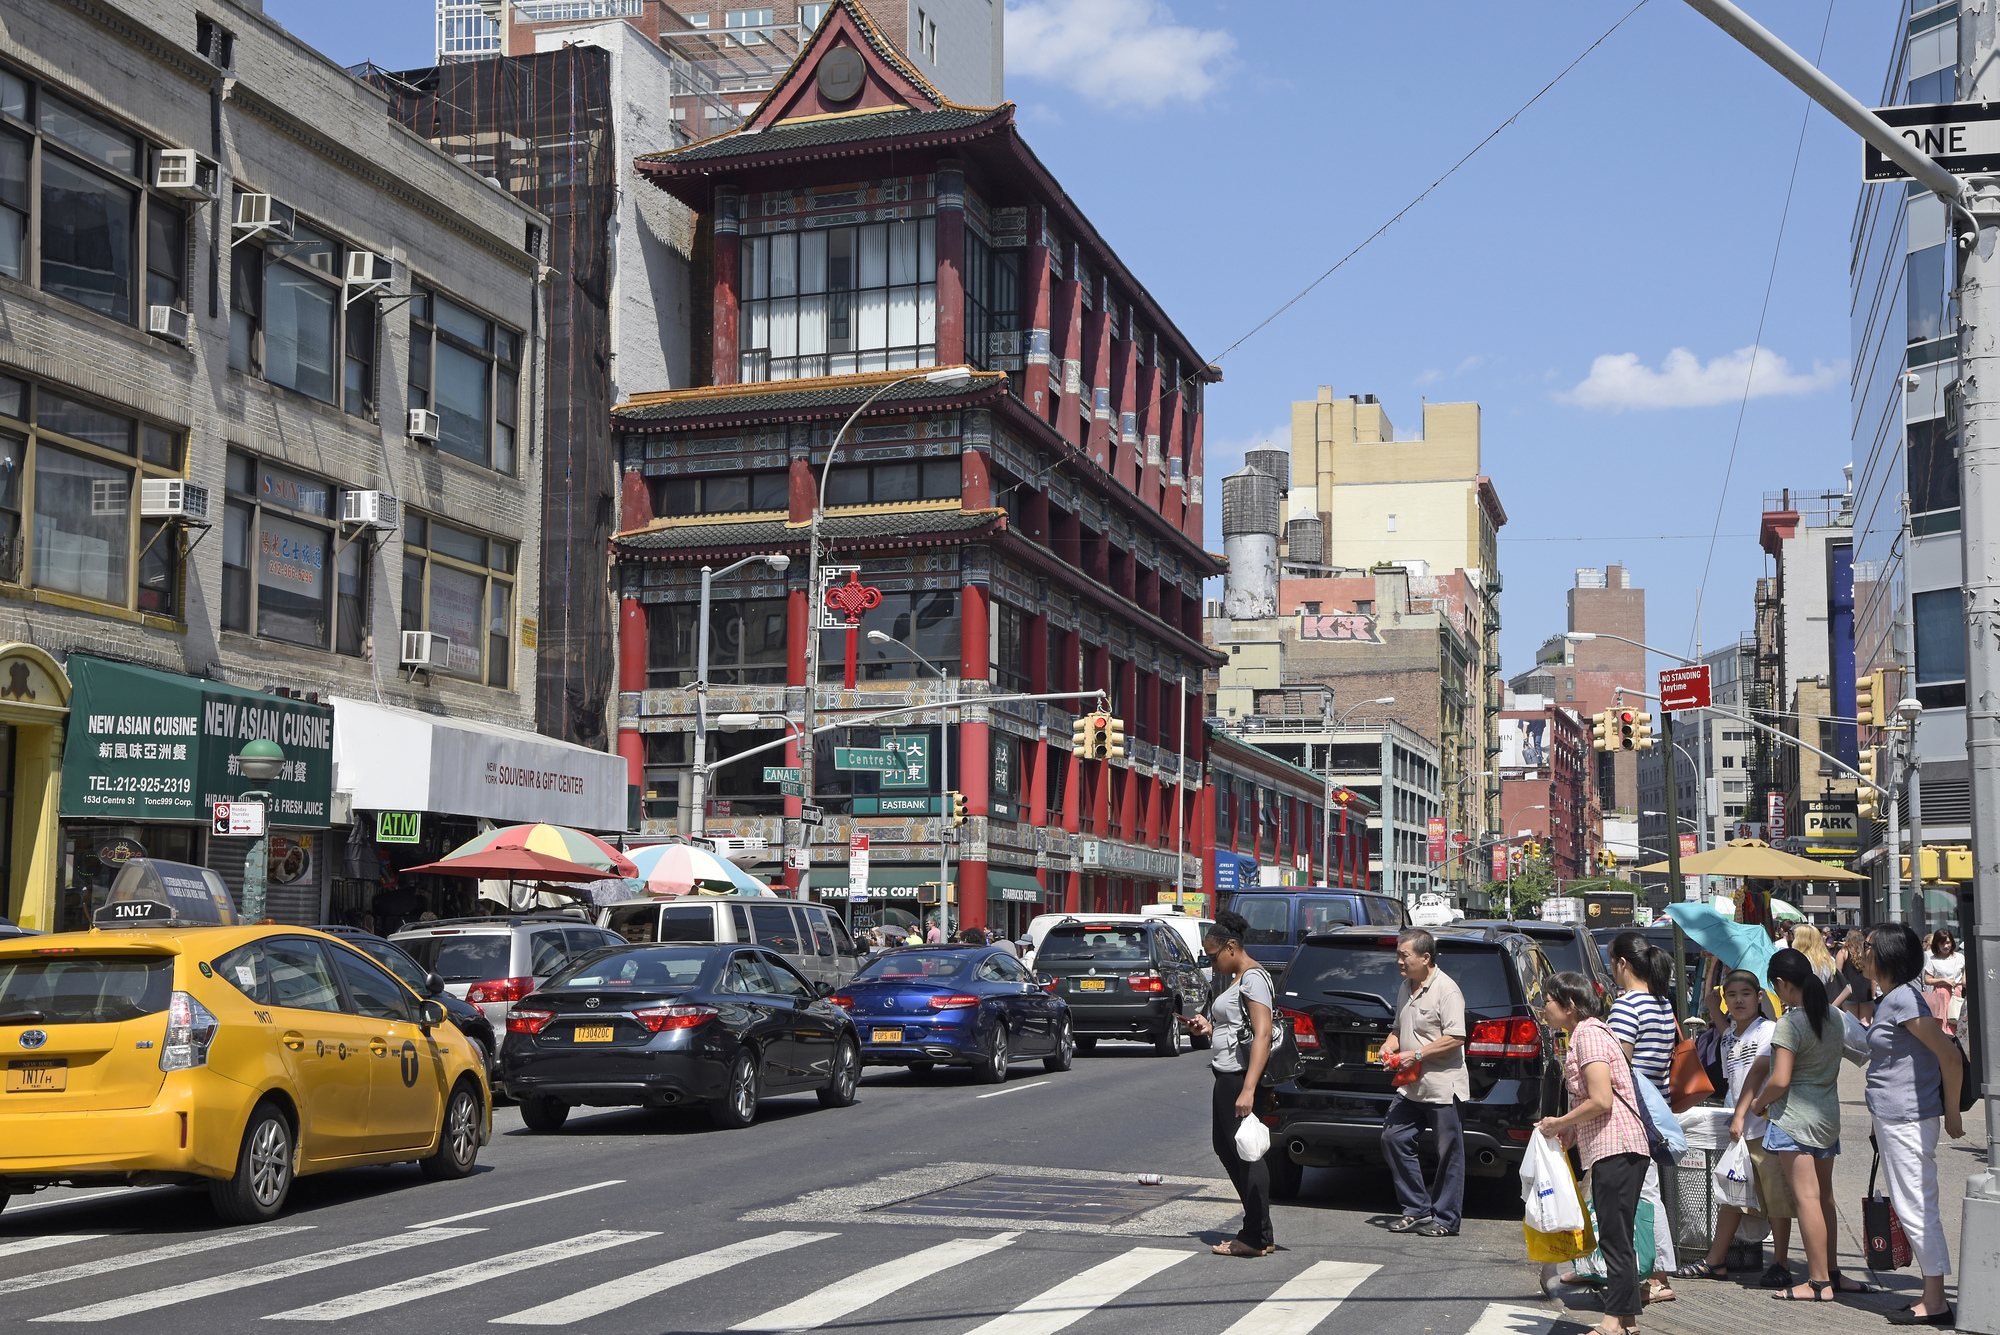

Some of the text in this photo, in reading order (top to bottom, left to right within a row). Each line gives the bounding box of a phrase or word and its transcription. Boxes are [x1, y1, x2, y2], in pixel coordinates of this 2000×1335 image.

[1902, 127, 1966, 154] ONE
[269, 561, 313, 584] 212-966-6296
[1661, 670, 1701, 683] NO STANDING
[1663, 683, 1687, 693] Anytime
[88, 715, 198, 736] NEW ASIAN CUISINE
[204, 701, 330, 750] NEW ASIAN CUISINE
[99, 742, 187, 760] 新風味亞洲餐
[849, 753, 897, 766] Centre St
[486, 762, 498, 772] NEW
[485, 774, 498, 785] YORK
[499, 766, 584, 795] SOUVENIR & GIFT CENTER
[765, 769, 795, 781] CANAL
[88, 776, 191, 793] TEL:212-925-2319
[781, 781, 799, 796] CENTRE
[83, 795, 101, 804] 153d
[102, 796, 126, 805] Centre
[127, 796, 136, 805] St
[174, 798, 193, 808] Corp.
[274, 799, 324, 816] & FRESH JUICE
[882, 801, 926, 810] EASTBANK
[1809, 802, 1841, 811] Edison
[804, 810, 812, 820] ONE
[381, 812, 416, 836] ATM
[1809, 817, 1853, 830] PARK
[821, 887, 887, 897] STARCKS
[1002, 888, 1037, 902] STARBUCKS COFFEE
[115, 904, 152, 918] 1N17
[854, 904, 876, 916] GOOD
[854, 916, 876, 927] FEELS
[1637, 913, 1650, 923] Ex
[254, 1010, 273, 1024] 1N17
[578, 1027, 610, 1038] T730420C
[874, 1031, 888, 1040] POPS
[391, 1049, 401, 1057] NYC
